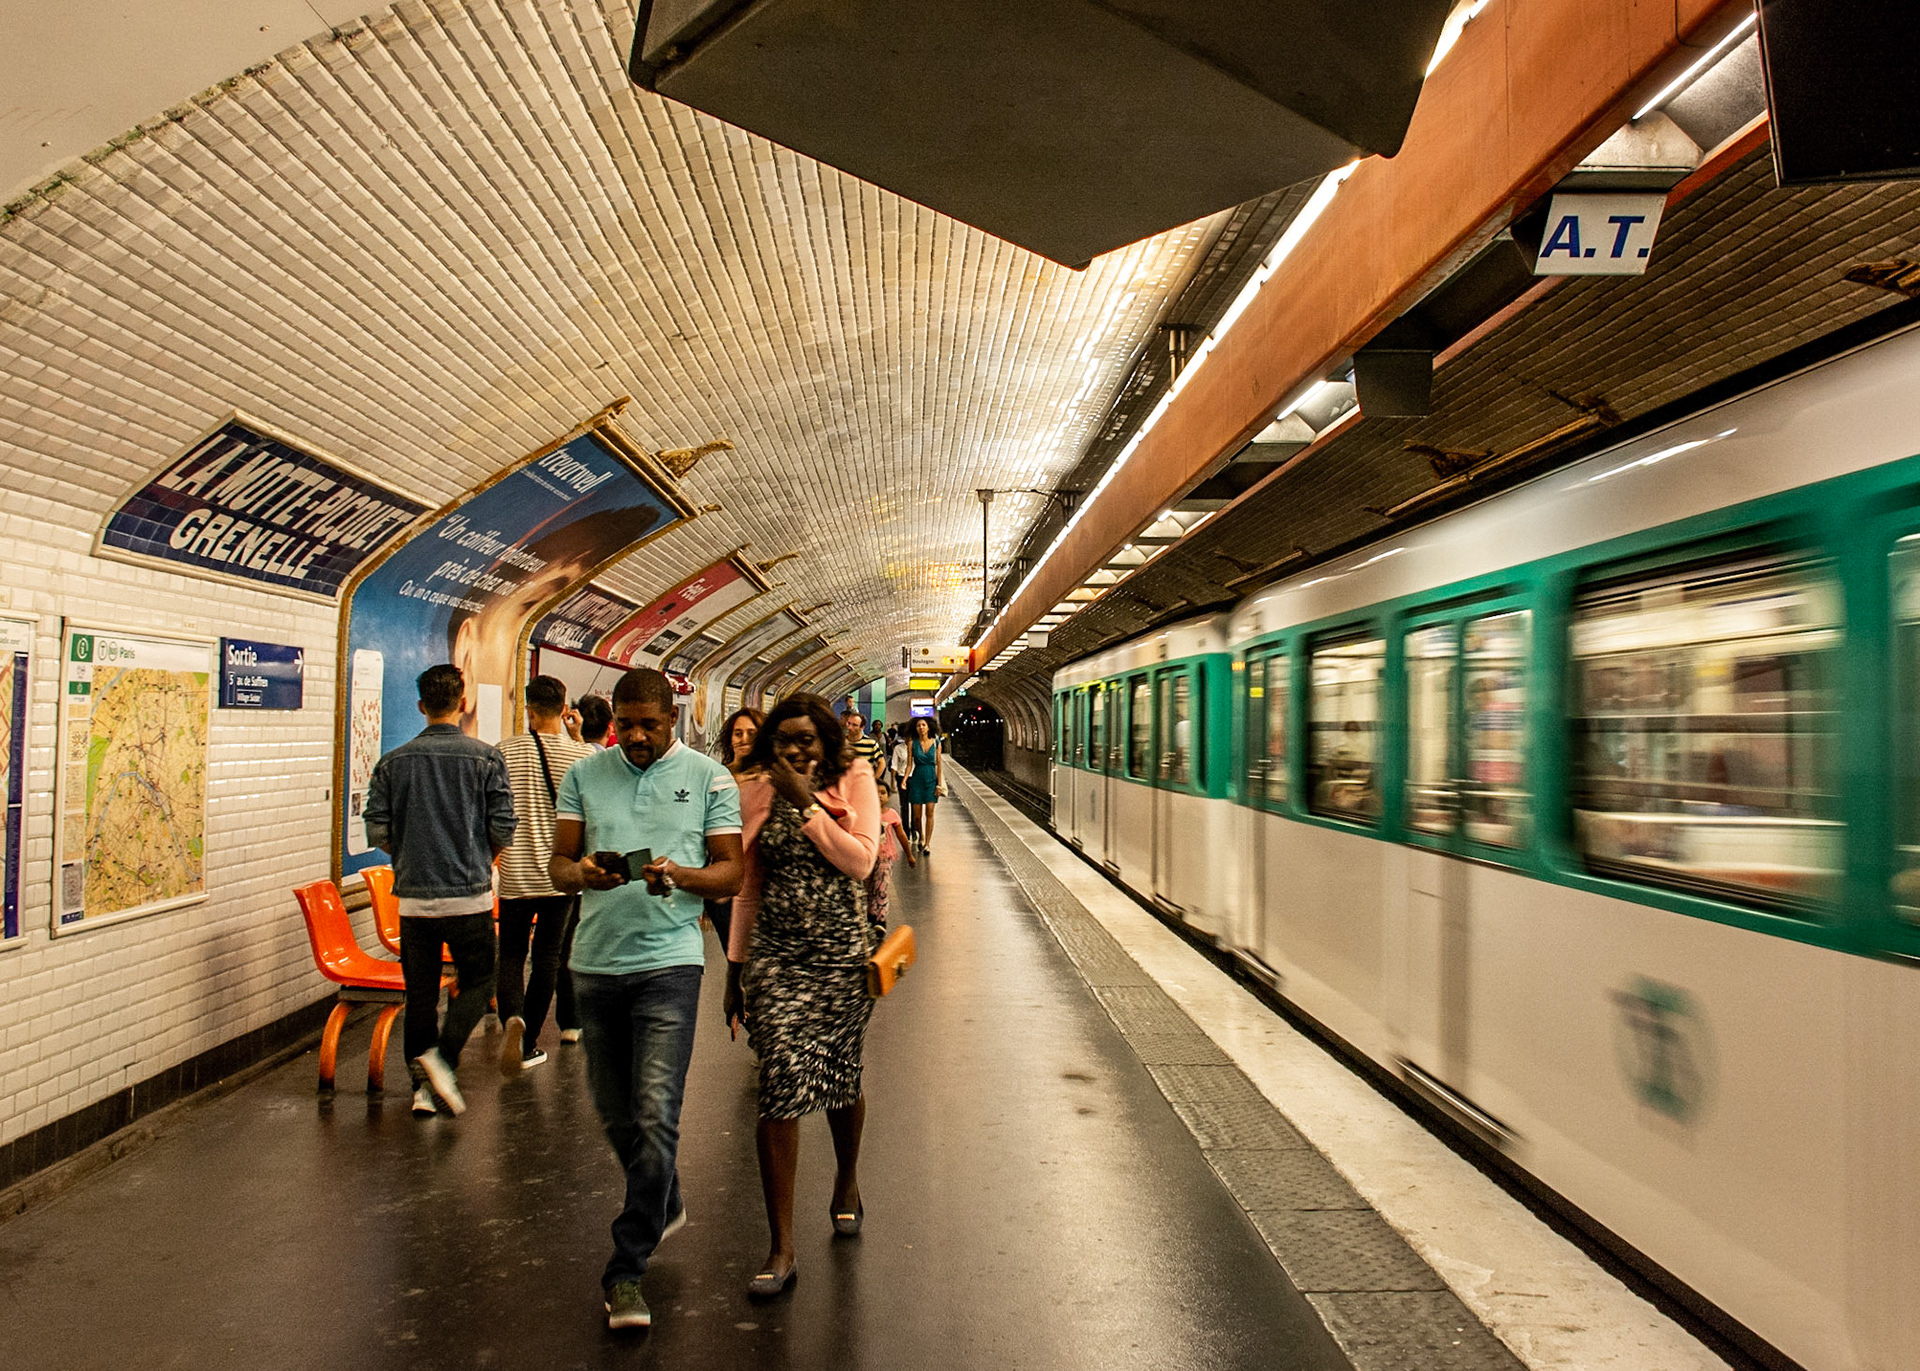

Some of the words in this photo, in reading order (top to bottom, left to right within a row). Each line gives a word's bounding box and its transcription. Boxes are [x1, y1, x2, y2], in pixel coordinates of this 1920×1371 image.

[1539, 215, 1650, 258] A.T.
[157, 433, 249, 495] LA
[538, 448, 614, 494] treatwell
[202, 450, 417, 551] MOTTE-PICQUET
[169, 508, 329, 579] GRENELLE
[456, 530, 507, 557] coiffeur
[426, 558, 469, 583] près
[458, 564, 485, 585] de
[473, 569, 503, 592] chez
[544, 619, 592, 649] GRENELLE
[119, 646, 136, 659] Paris
[227, 644, 258, 667] Sortie
[244, 675, 251, 686] de
